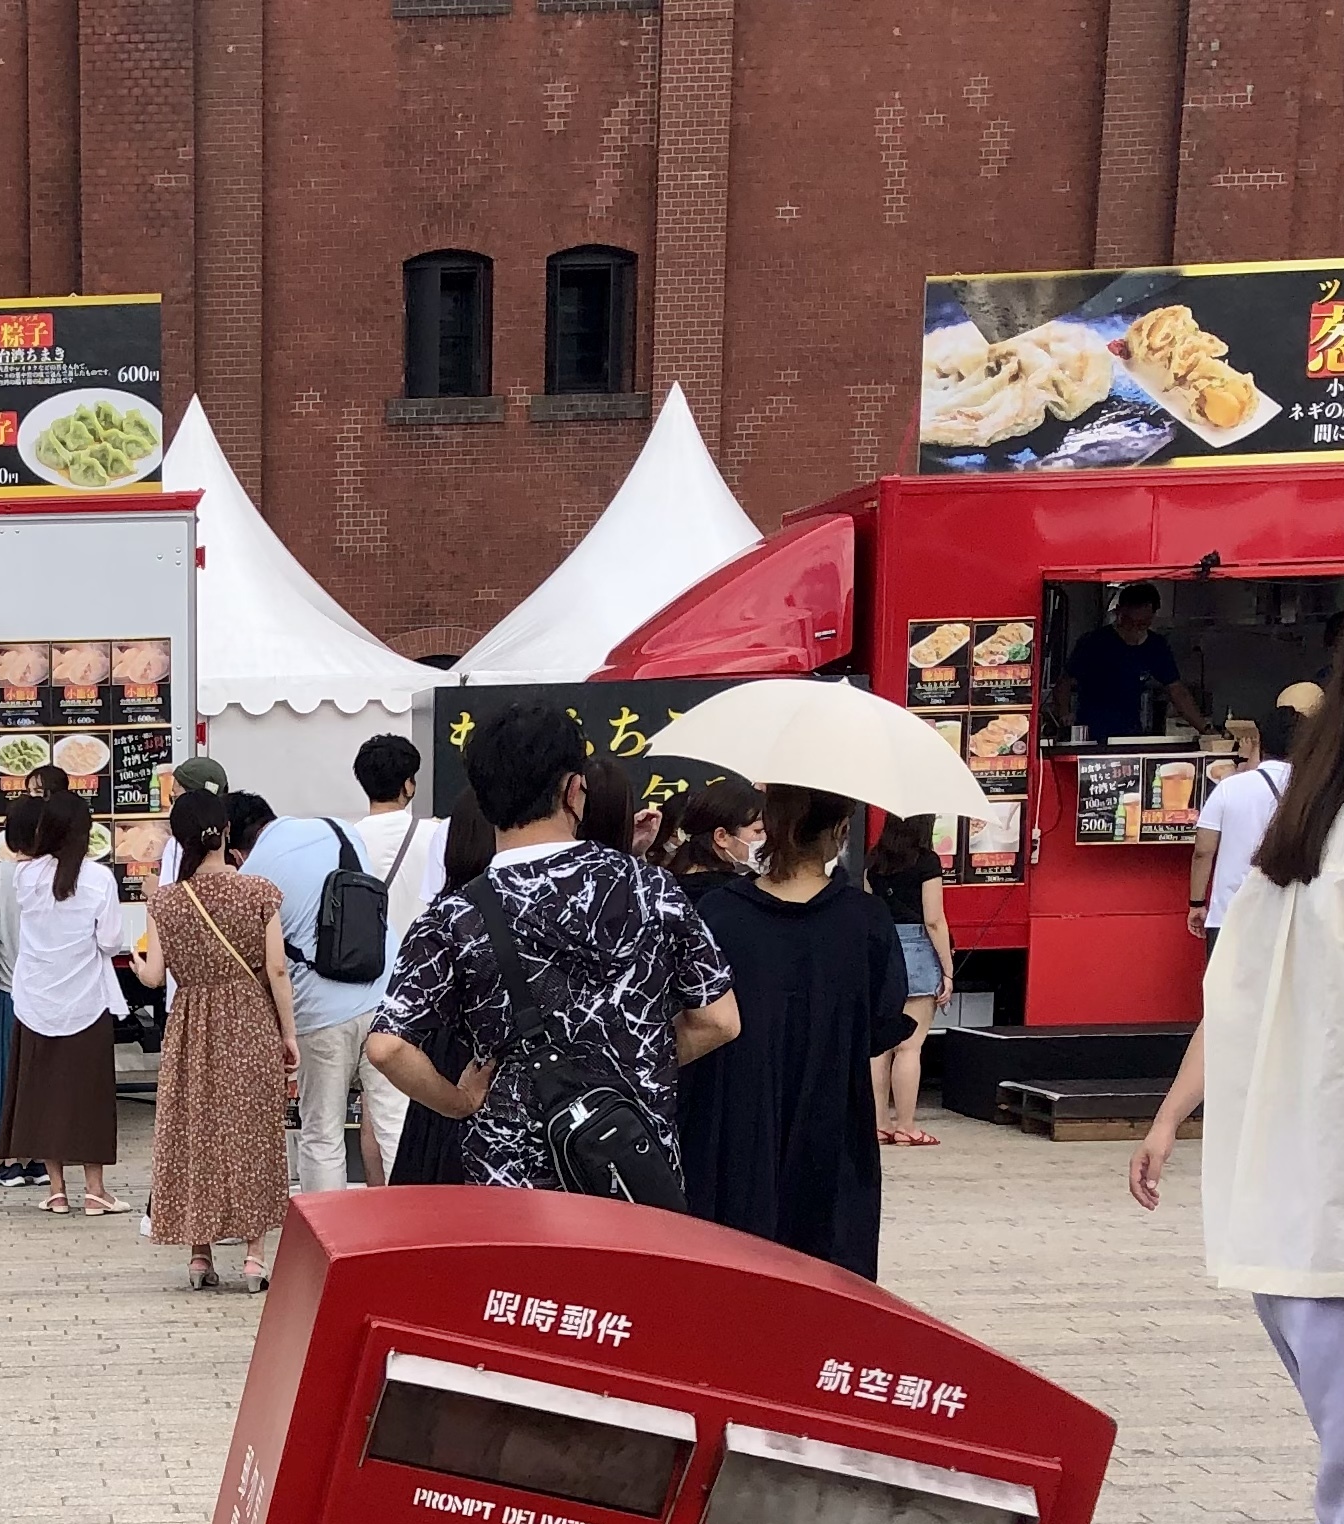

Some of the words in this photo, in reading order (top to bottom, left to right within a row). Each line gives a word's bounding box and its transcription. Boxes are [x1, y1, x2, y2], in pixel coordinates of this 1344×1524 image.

[0, 321, 48, 347] 粽子
[117, 365, 160, 383] 600円
[117, 790, 148, 803] 500円
[1081, 819, 1113, 831] 500円
[483, 1289, 633, 1347] 限時郵件
[816, 1358, 968, 1418] 航空郵件
[413, 1487, 496, 1521] PROMPT
